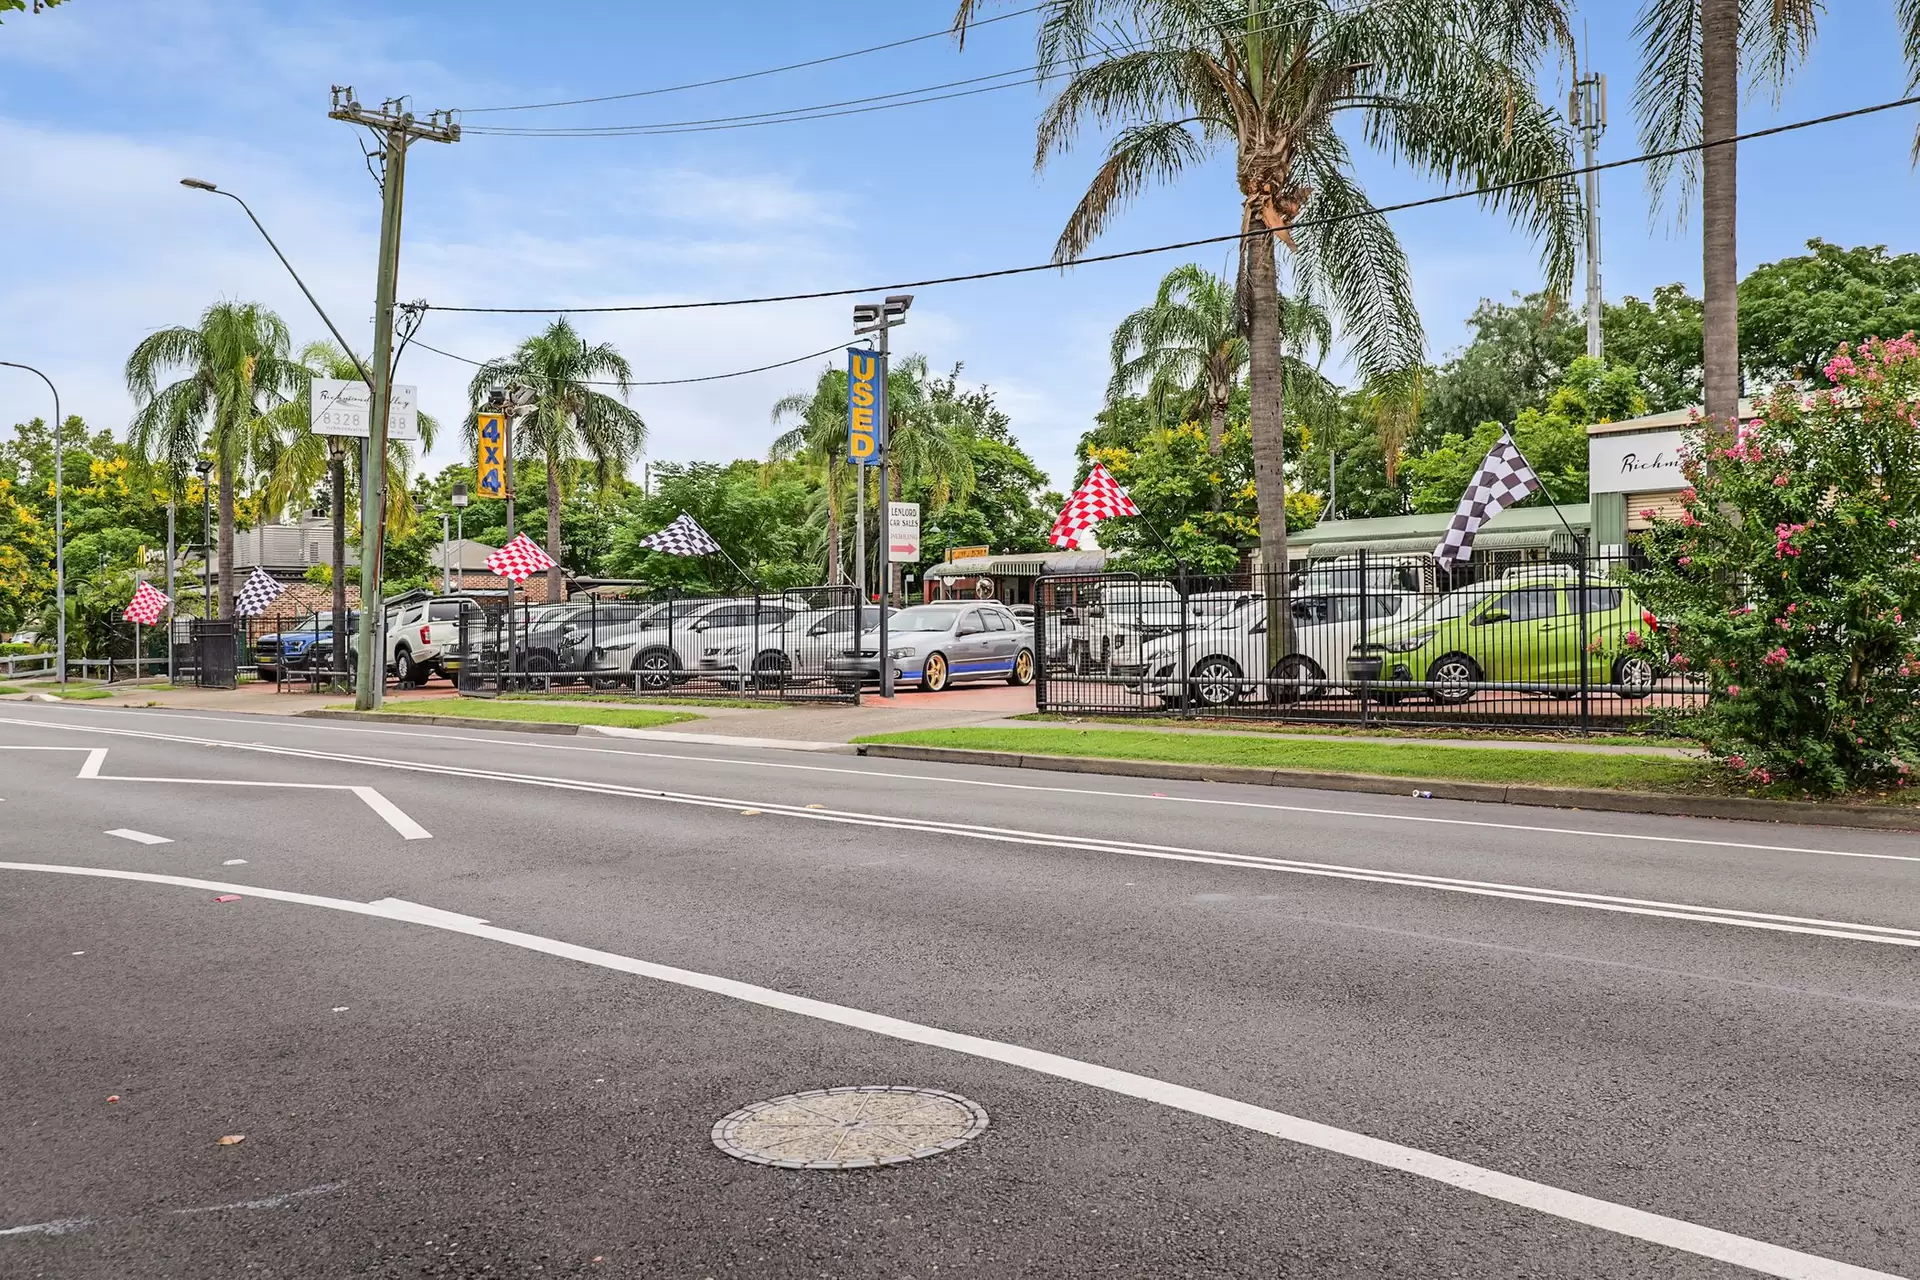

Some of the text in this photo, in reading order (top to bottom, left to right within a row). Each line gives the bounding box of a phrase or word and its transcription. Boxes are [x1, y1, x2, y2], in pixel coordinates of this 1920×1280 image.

[850, 355, 875, 457] USED
[323, 412, 360, 426] 8328
[1621, 452, 1679, 474] Richm
[889, 519, 919, 528] CAR SALES
